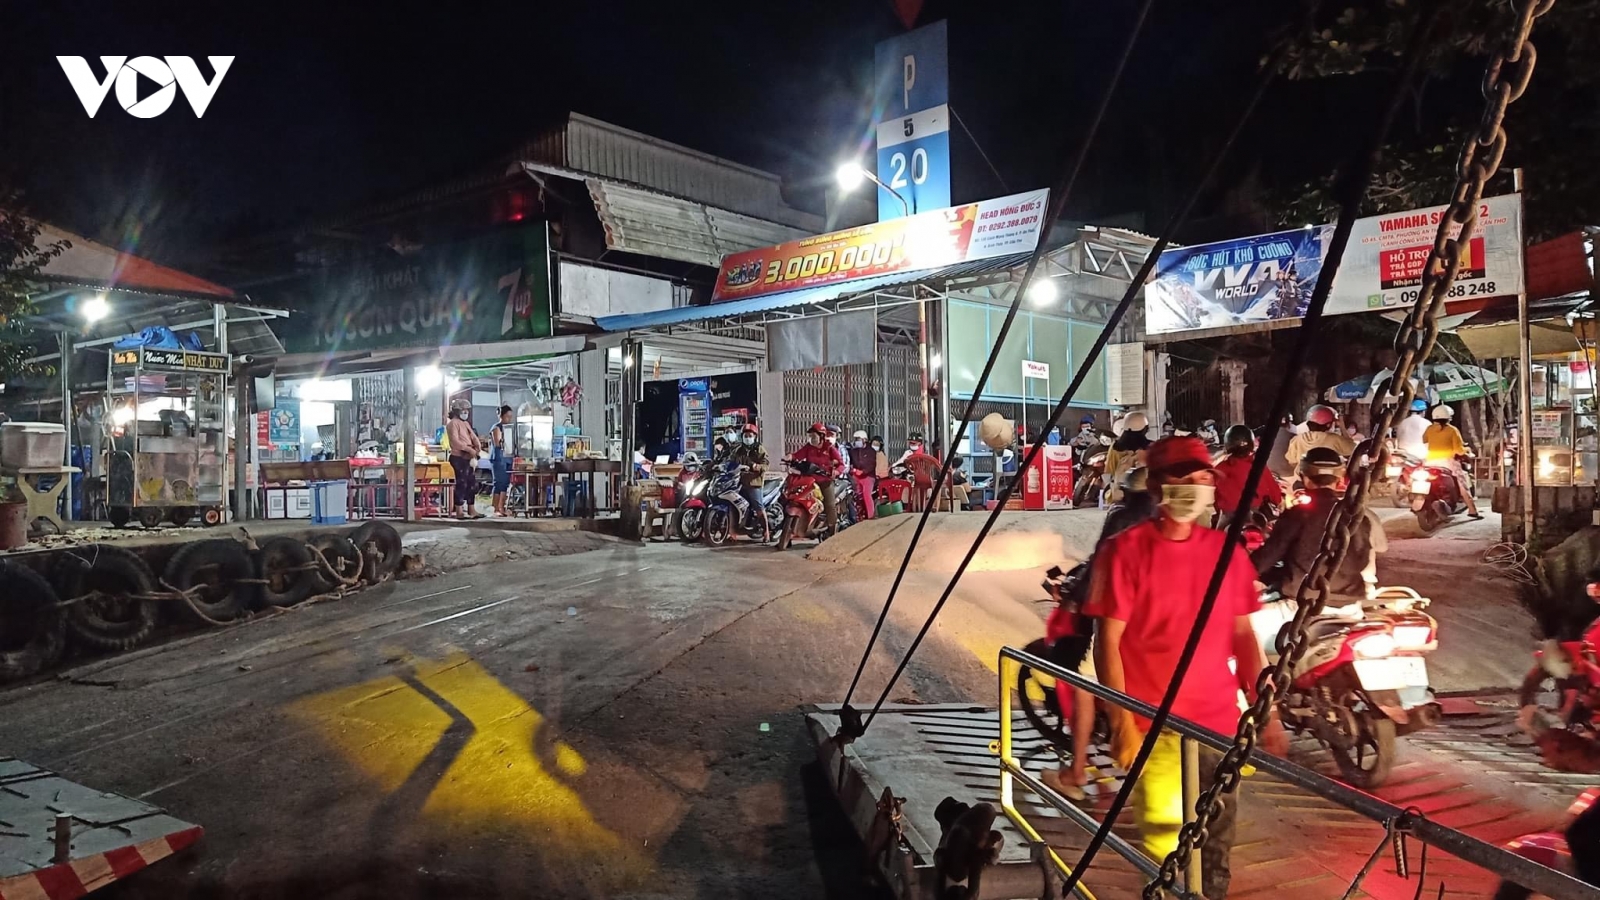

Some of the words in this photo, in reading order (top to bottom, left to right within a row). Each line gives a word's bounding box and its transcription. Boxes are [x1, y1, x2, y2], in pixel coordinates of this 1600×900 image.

[904, 54, 916, 110] P
[903, 118, 914, 137] 5
[890, 147, 928, 189] 20
[980, 210, 998, 220] HEAD
[1380, 214, 1428, 232] YAMAHA
[1480, 205, 1488, 218] 2
[1212, 250, 1230, 266] HÚT
[1234, 244, 1254, 264] KHÓ
[1407, 260, 1422, 268] GÓP
[1393, 279, 1412, 287] Nhận
[1458, 270, 1472, 280] gốc
[1215, 284, 1258, 300] WORLD
[1468, 282, 1496, 296] 248
[144, 351, 164, 364] Nước
[166, 354, 184, 365] Mía
[209, 356, 224, 368] DUY
